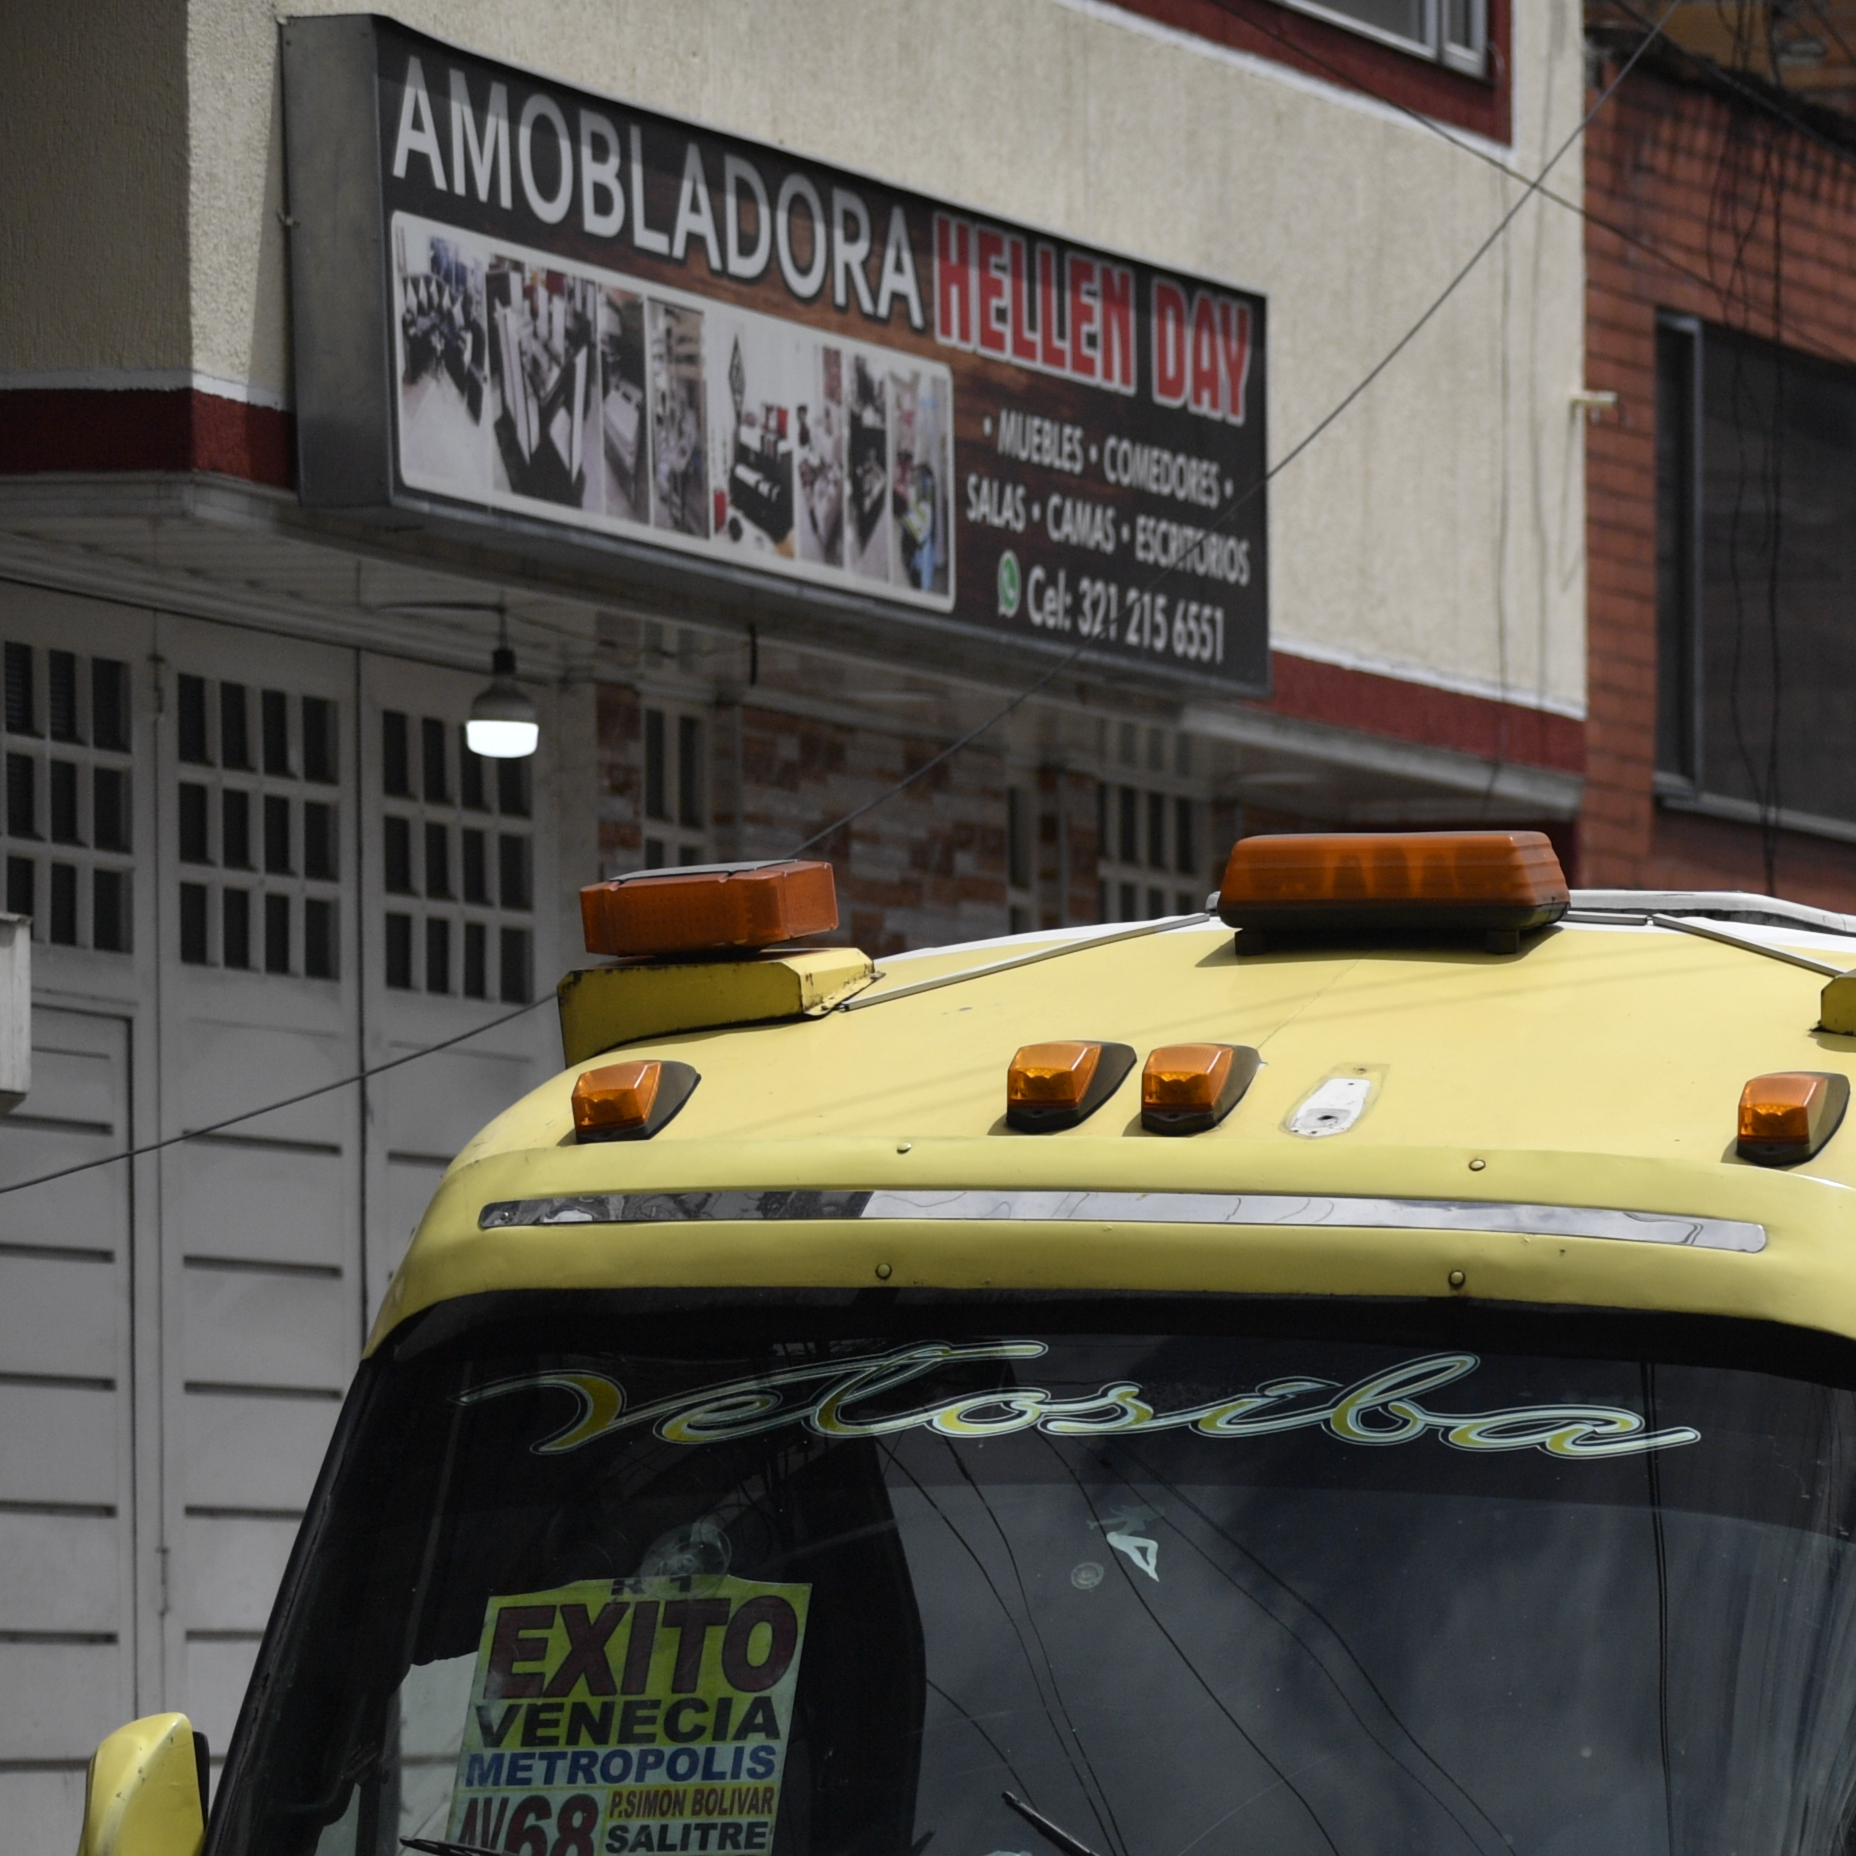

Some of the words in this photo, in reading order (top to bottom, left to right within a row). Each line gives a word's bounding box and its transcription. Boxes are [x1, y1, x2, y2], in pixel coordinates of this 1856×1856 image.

[393, 56, 925, 330] AMOBLADORA
[934, 213, 1137, 397] HELLEN
[1152, 278, 1251, 427] DAY
[998, 409, 1083, 475] MUEBLES
[1103, 434, 1219, 508] COMEDORES
[966, 472, 1026, 533] SALAS
[1047, 493, 1116, 555] CAMAS
[1135, 514, 1249, 586] ESCRITORIOS
[1027, 564, 1073, 631] Cel:
[1078, 576, 1118, 641] 321
[1125, 586, 1168, 653] 215
[1172, 599, 1224, 664] 6551
[483, 1595, 799, 1699] EXITO
[465, 1744, 777, 1788] METROPOLIS
[474, 1696, 781, 1748] VENECIA
[605, 1822, 769, 1854] SALITRE
[609, 1788, 687, 1819] P.SIMON
[691, 1786, 775, 1817] BOLIVAR
